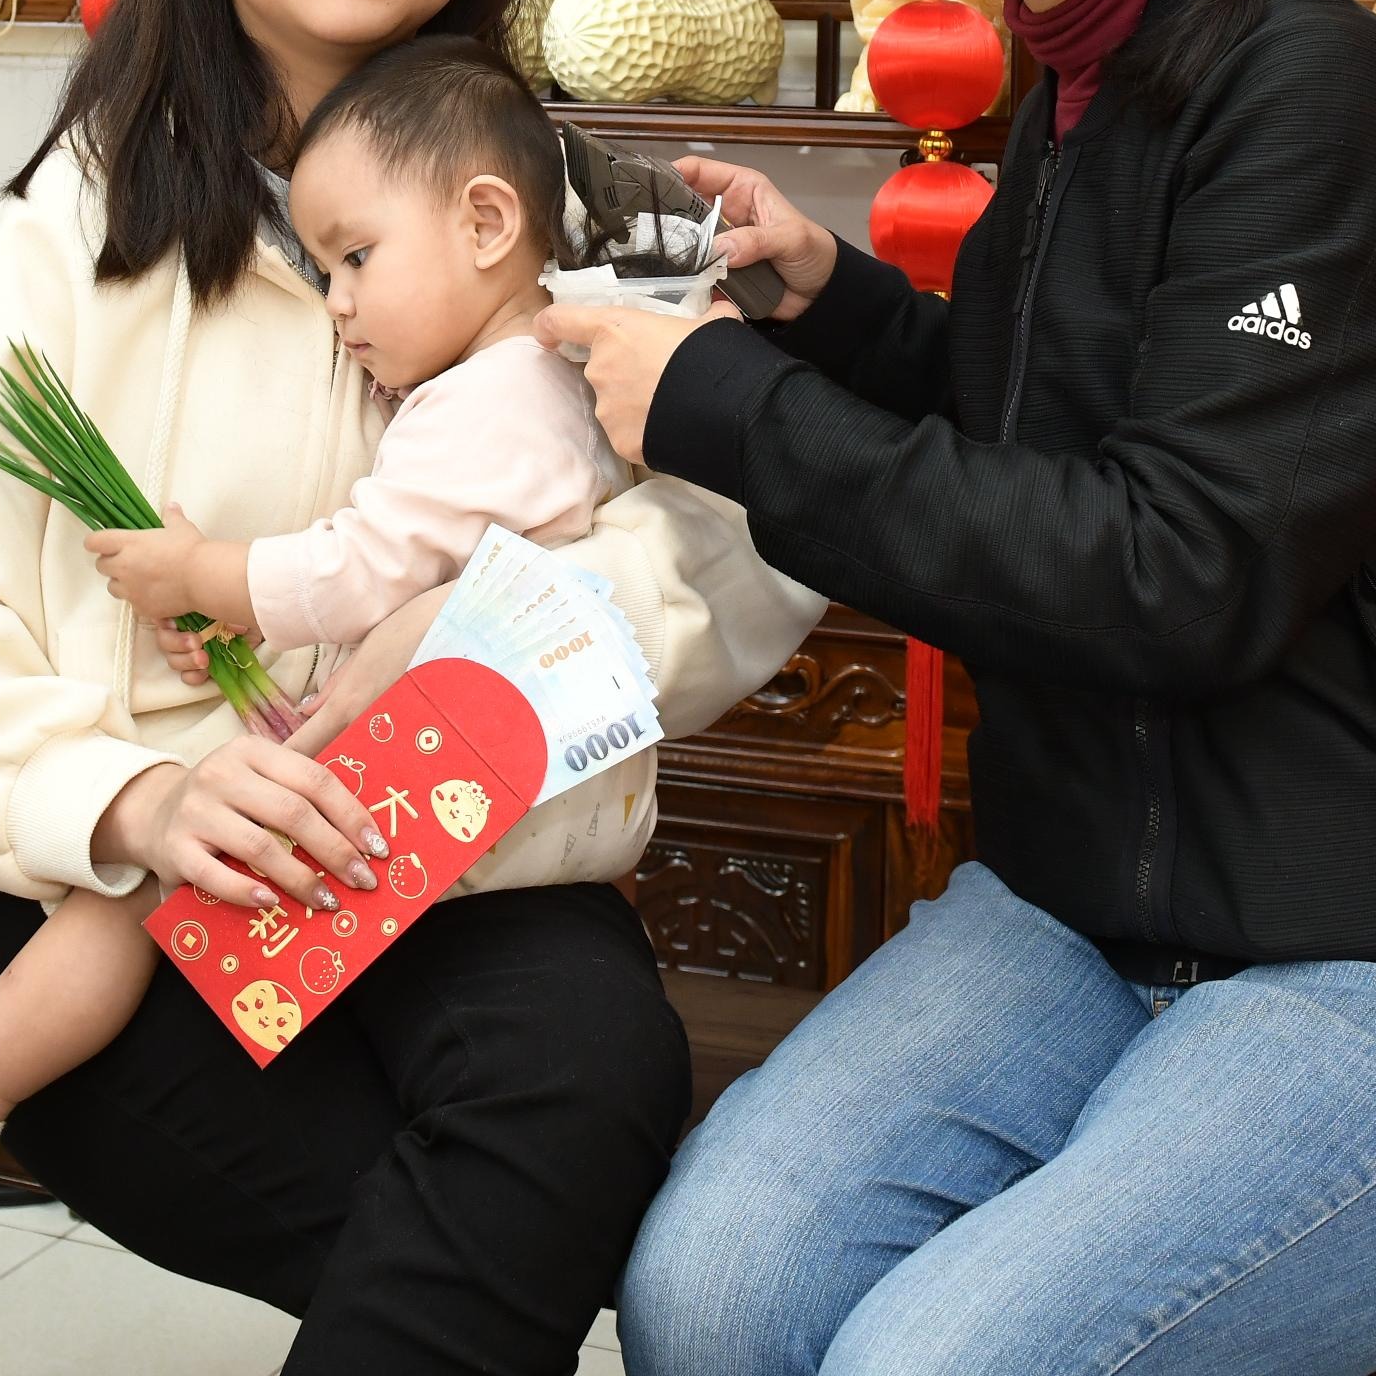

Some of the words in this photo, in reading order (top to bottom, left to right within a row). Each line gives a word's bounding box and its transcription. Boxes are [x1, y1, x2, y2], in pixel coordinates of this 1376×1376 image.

[1227, 315, 1312, 350] adidas
[539, 630, 594, 669] 1000
[564, 712, 647, 772] 1000
